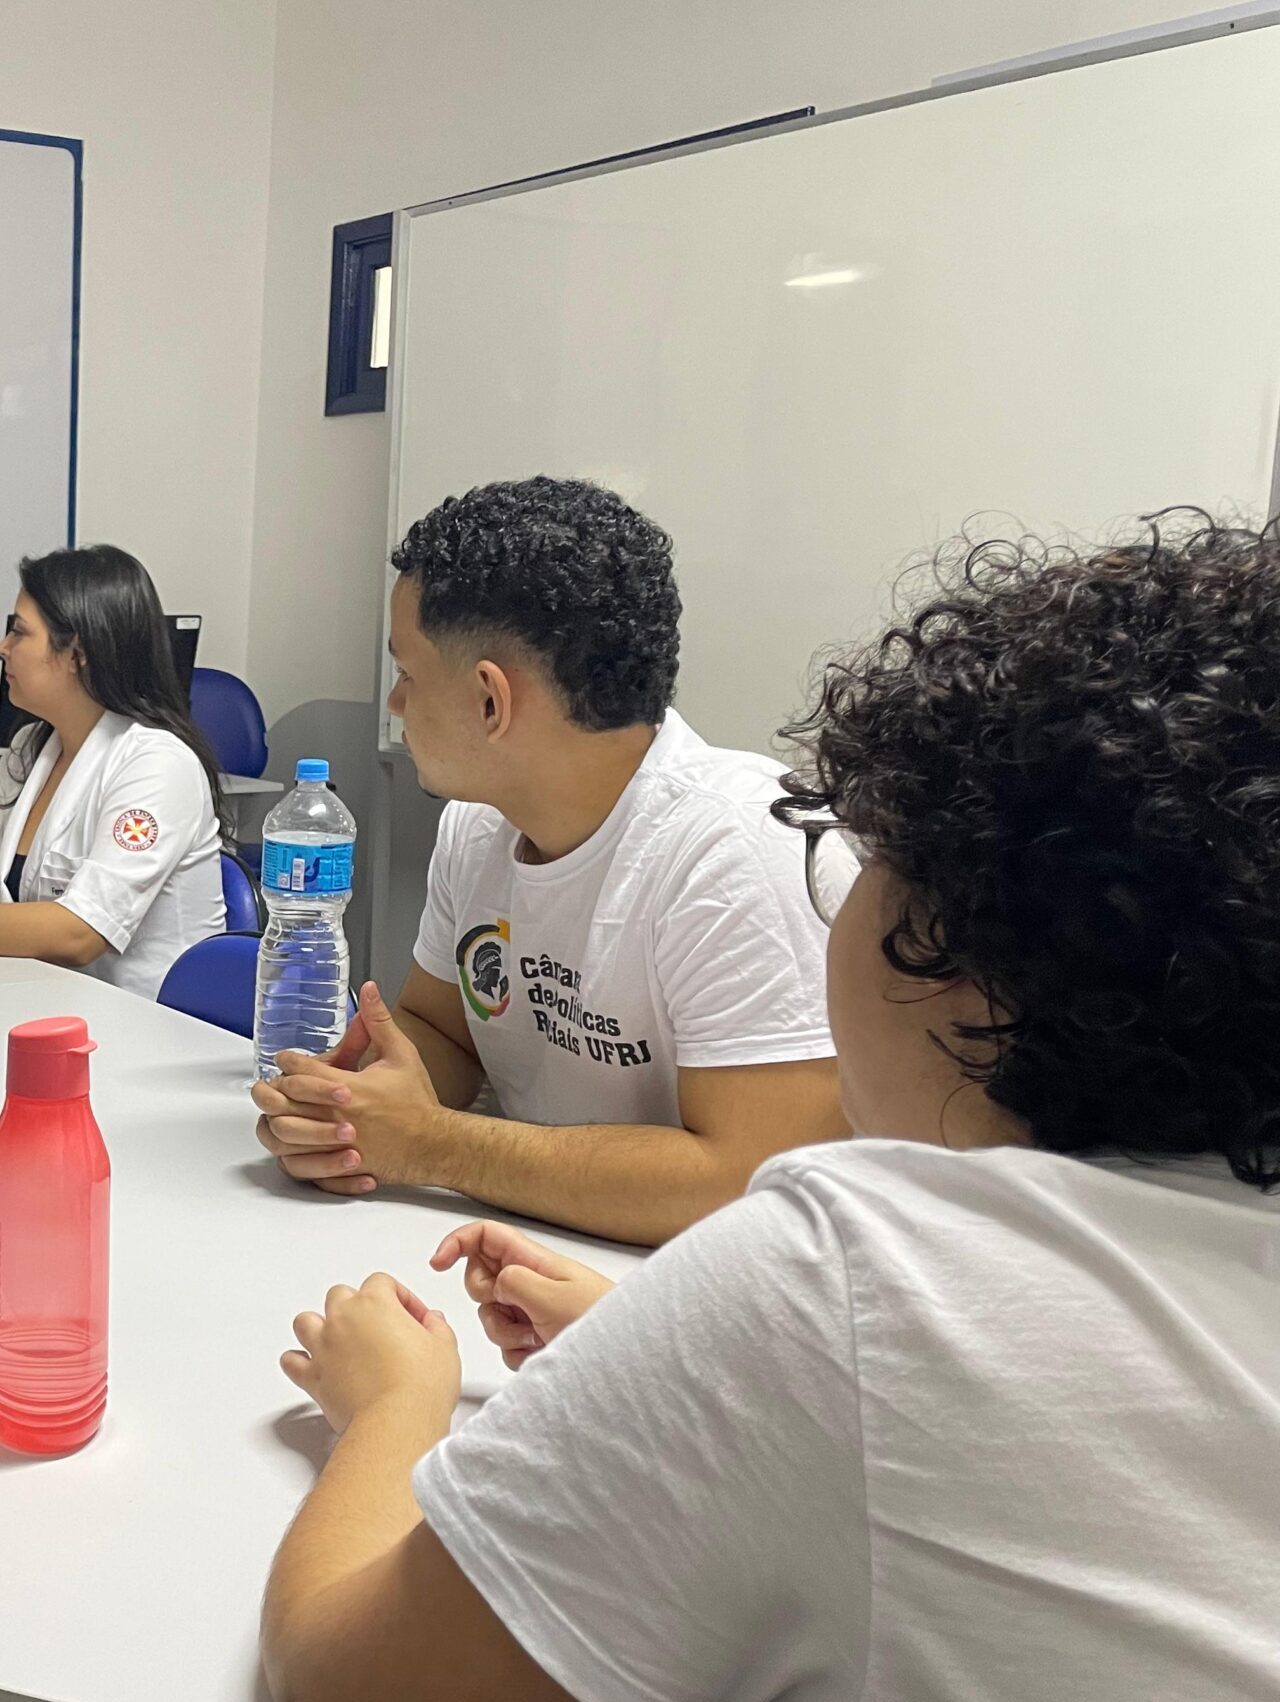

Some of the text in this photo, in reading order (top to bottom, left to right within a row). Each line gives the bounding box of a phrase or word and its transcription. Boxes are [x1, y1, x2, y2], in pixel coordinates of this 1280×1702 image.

[532, 1009, 652, 1068] Riais UFRJ
[554, 989, 622, 1037] olíticas
